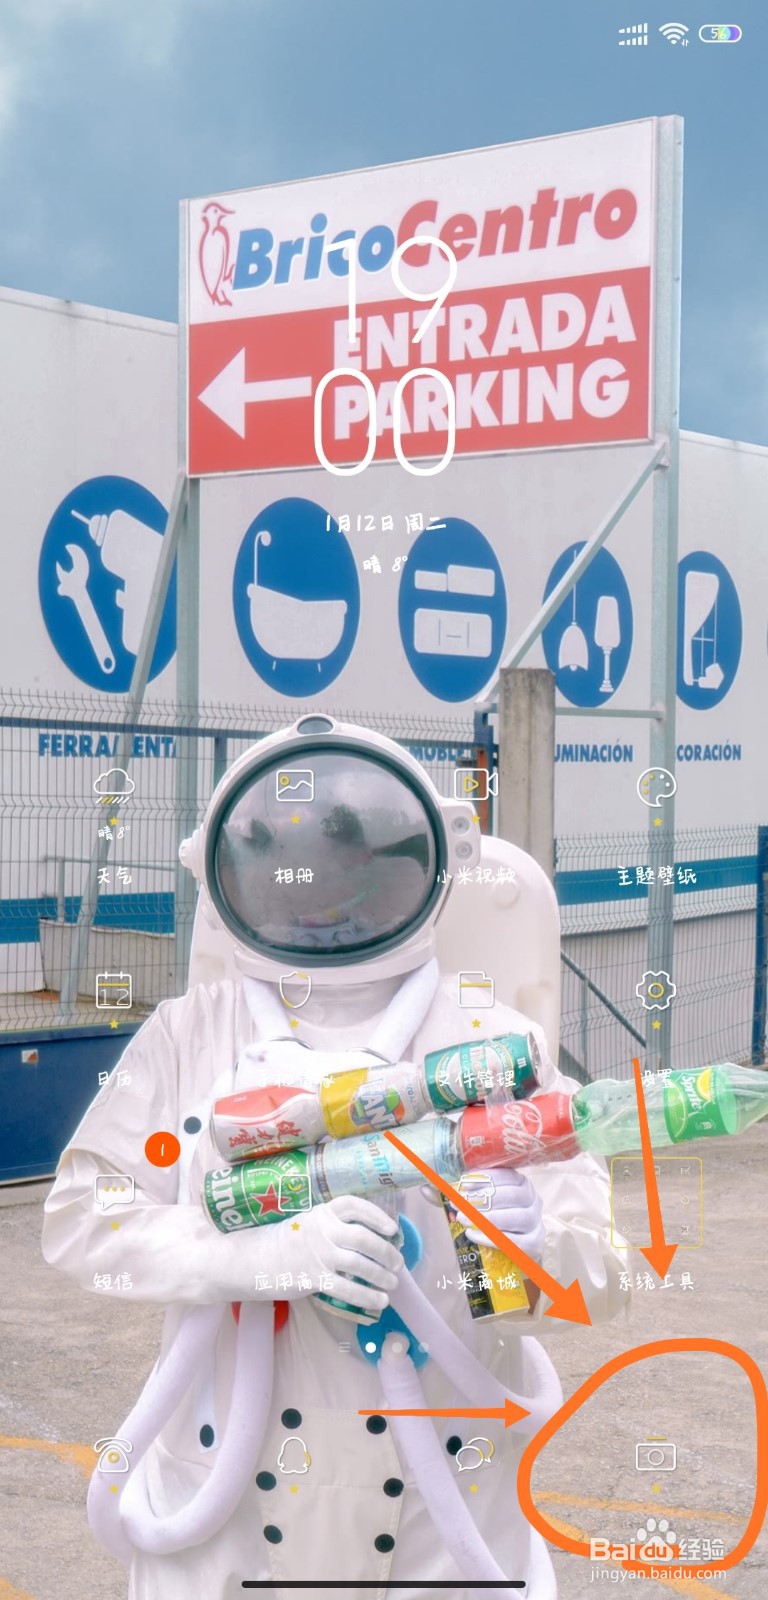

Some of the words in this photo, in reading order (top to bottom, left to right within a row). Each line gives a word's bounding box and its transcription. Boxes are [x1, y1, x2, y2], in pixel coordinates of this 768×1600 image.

[232, 187, 638, 291] BricoCentro
[324, 235, 457, 344] 19
[333, 285, 637, 373] ENTRADA
[333, 357, 630, 441] PARKING
[314, 367, 456, 476] 00
[326, 514, 394, 533] 1月12日
[405, 512, 447, 534] 周二
[362, 554, 382, 574] 晴
[38, 732, 176, 758] FERRAENT
[98, 825, 113, 841] 晴
[96, 866, 133, 885] 天气
[274, 867, 315, 884] 相册
[436, 866, 516, 885] 小米视频
[616, 866, 698, 886] 主题壁纸
[99, 988, 130, 1007] 12
[97, 1070, 132, 1088] 日历
[438, 1068, 517, 1089] 文件管理
[93, 1272, 133, 1291] 短信
[254, 1271, 335, 1291] 应用商店
[436, 1272, 519, 1291] 小米商城
[617, 1271, 695, 1291] 系统工具
